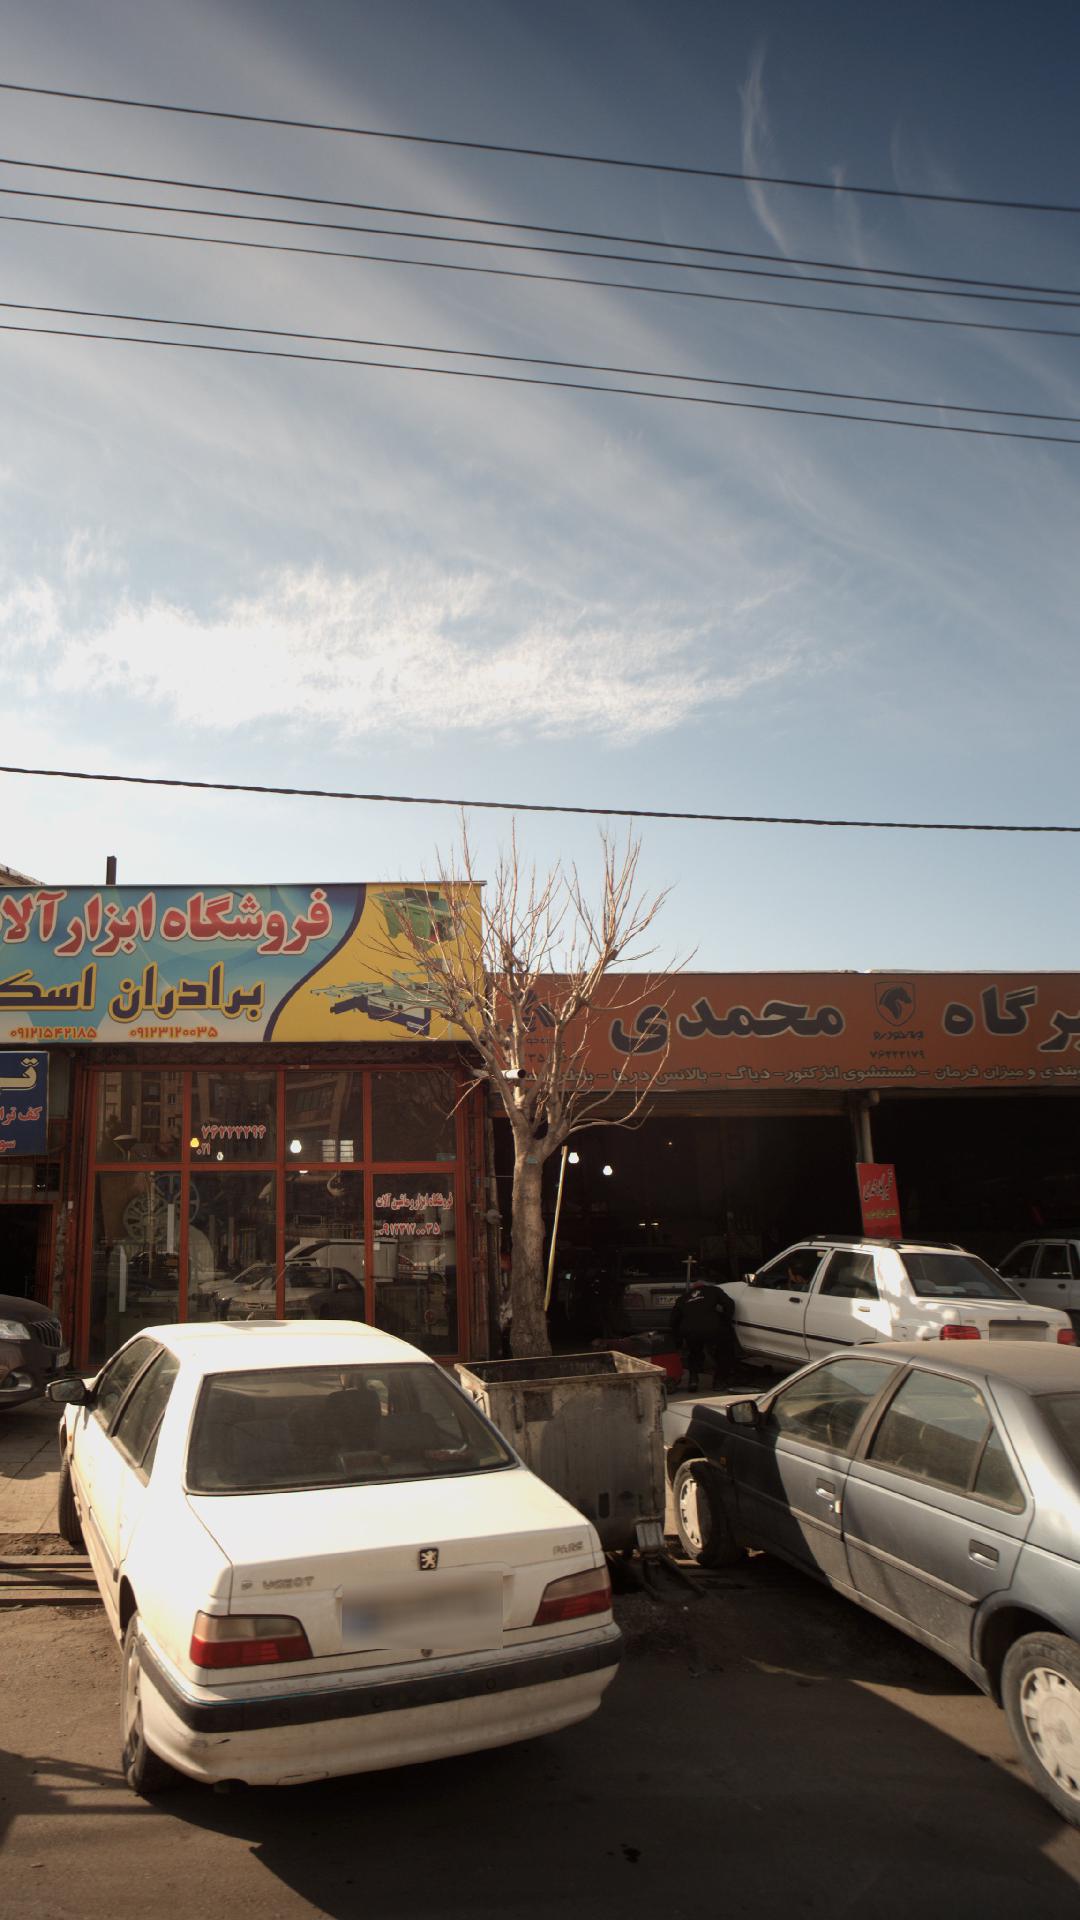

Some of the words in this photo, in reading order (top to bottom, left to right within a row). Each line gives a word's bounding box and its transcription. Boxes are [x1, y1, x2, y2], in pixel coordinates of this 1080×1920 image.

[0, 890, 67, 943] آلا
[54, 891, 156, 956] ابزار
[160, 888, 333, 955] فروشگاه
[0, 962, 97, 1012] اسک
[109, 961, 266, 1023] برادران
[129, 1026, 218, 1039] ۰۹۱۲۳۱۲۰۰۳۵
[608, 996, 846, 1056] محمدی
[654, 1067, 708, 1085] بالانس
[726, 1067, 770, 1080] دیاگ
[842, 1065, 917, 1081] شستشوی
[934, 1066, 979, 1080] فرمان
[983, 1066, 1024, 1080] میزان
[1040, 1066, 1080, 1080] بندی
[0, 1106, 17, 1126] ترا
